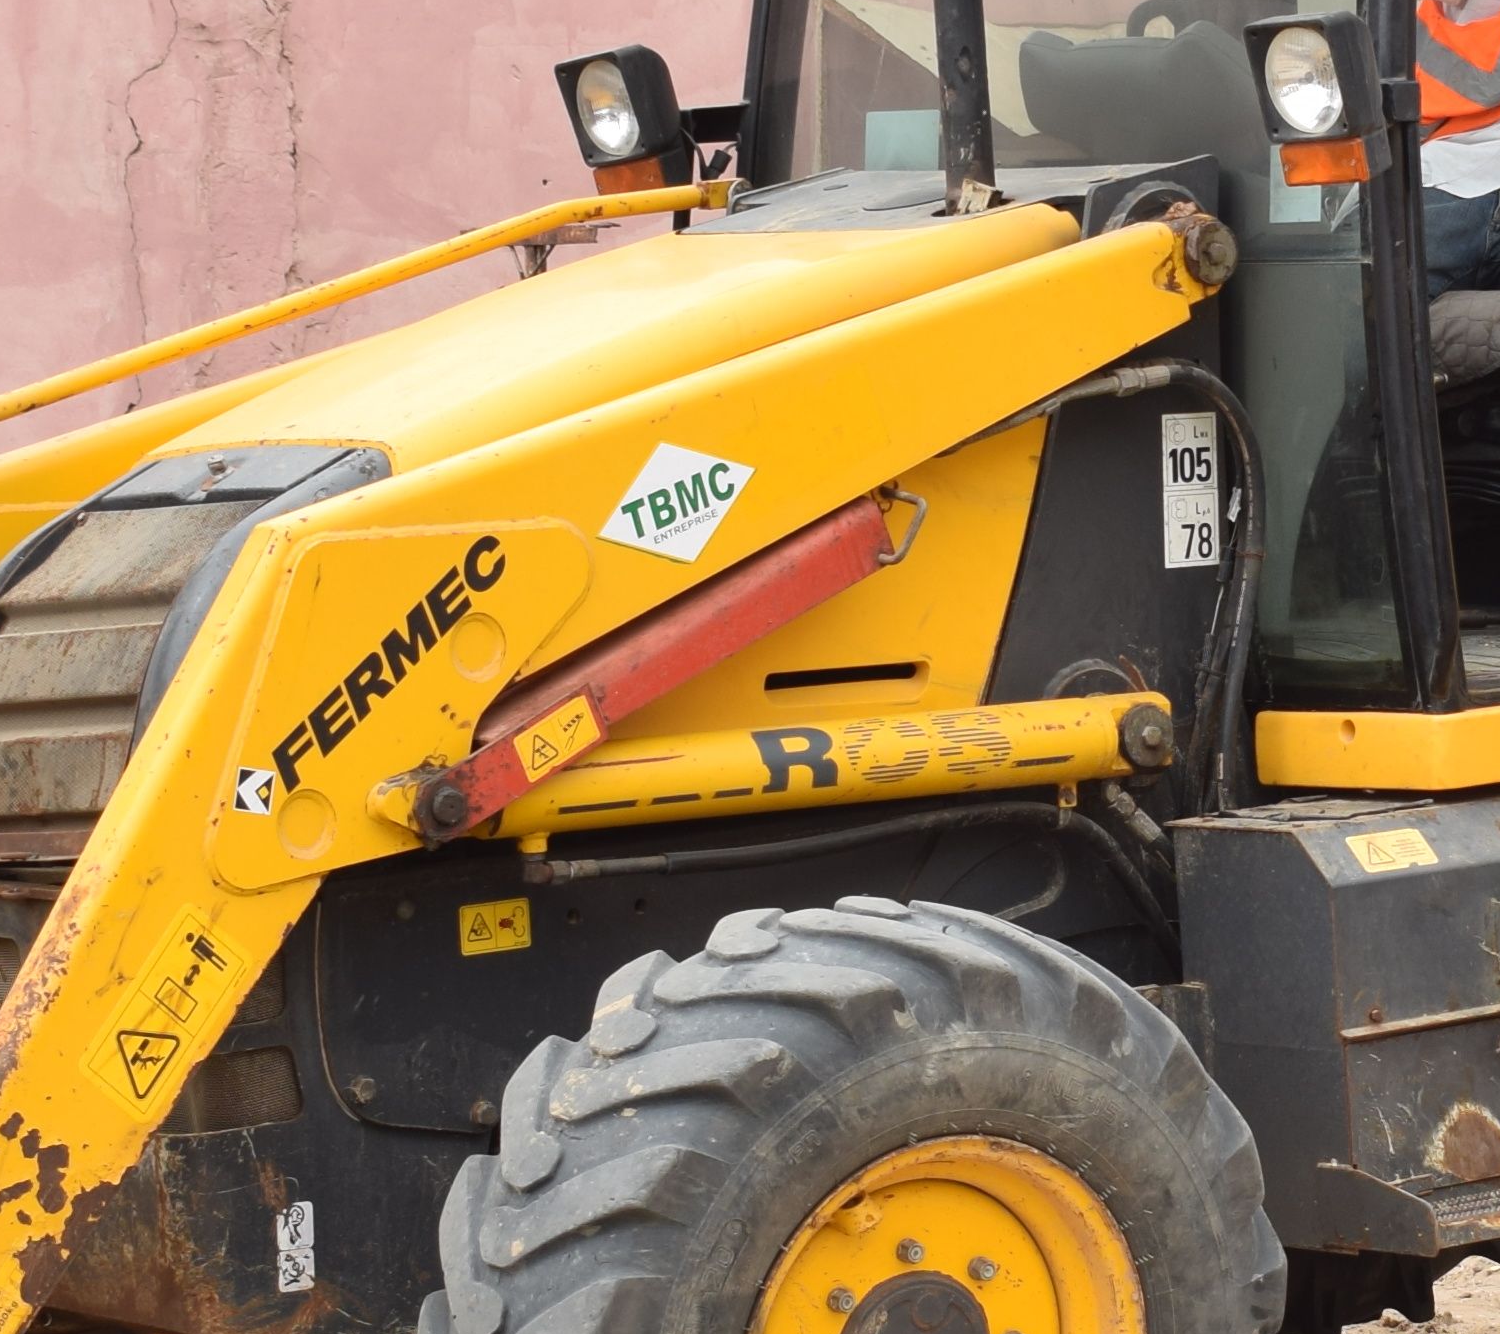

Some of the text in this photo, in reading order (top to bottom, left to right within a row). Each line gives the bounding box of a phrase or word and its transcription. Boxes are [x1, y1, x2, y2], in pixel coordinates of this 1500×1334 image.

[1168, 446, 1212, 484] 105
[620, 462, 735, 539] TBMC
[653, 508, 719, 545] ENTREPRISE
[1180, 522, 1213, 560] 78
[271, 534, 506, 793] FERMEC
